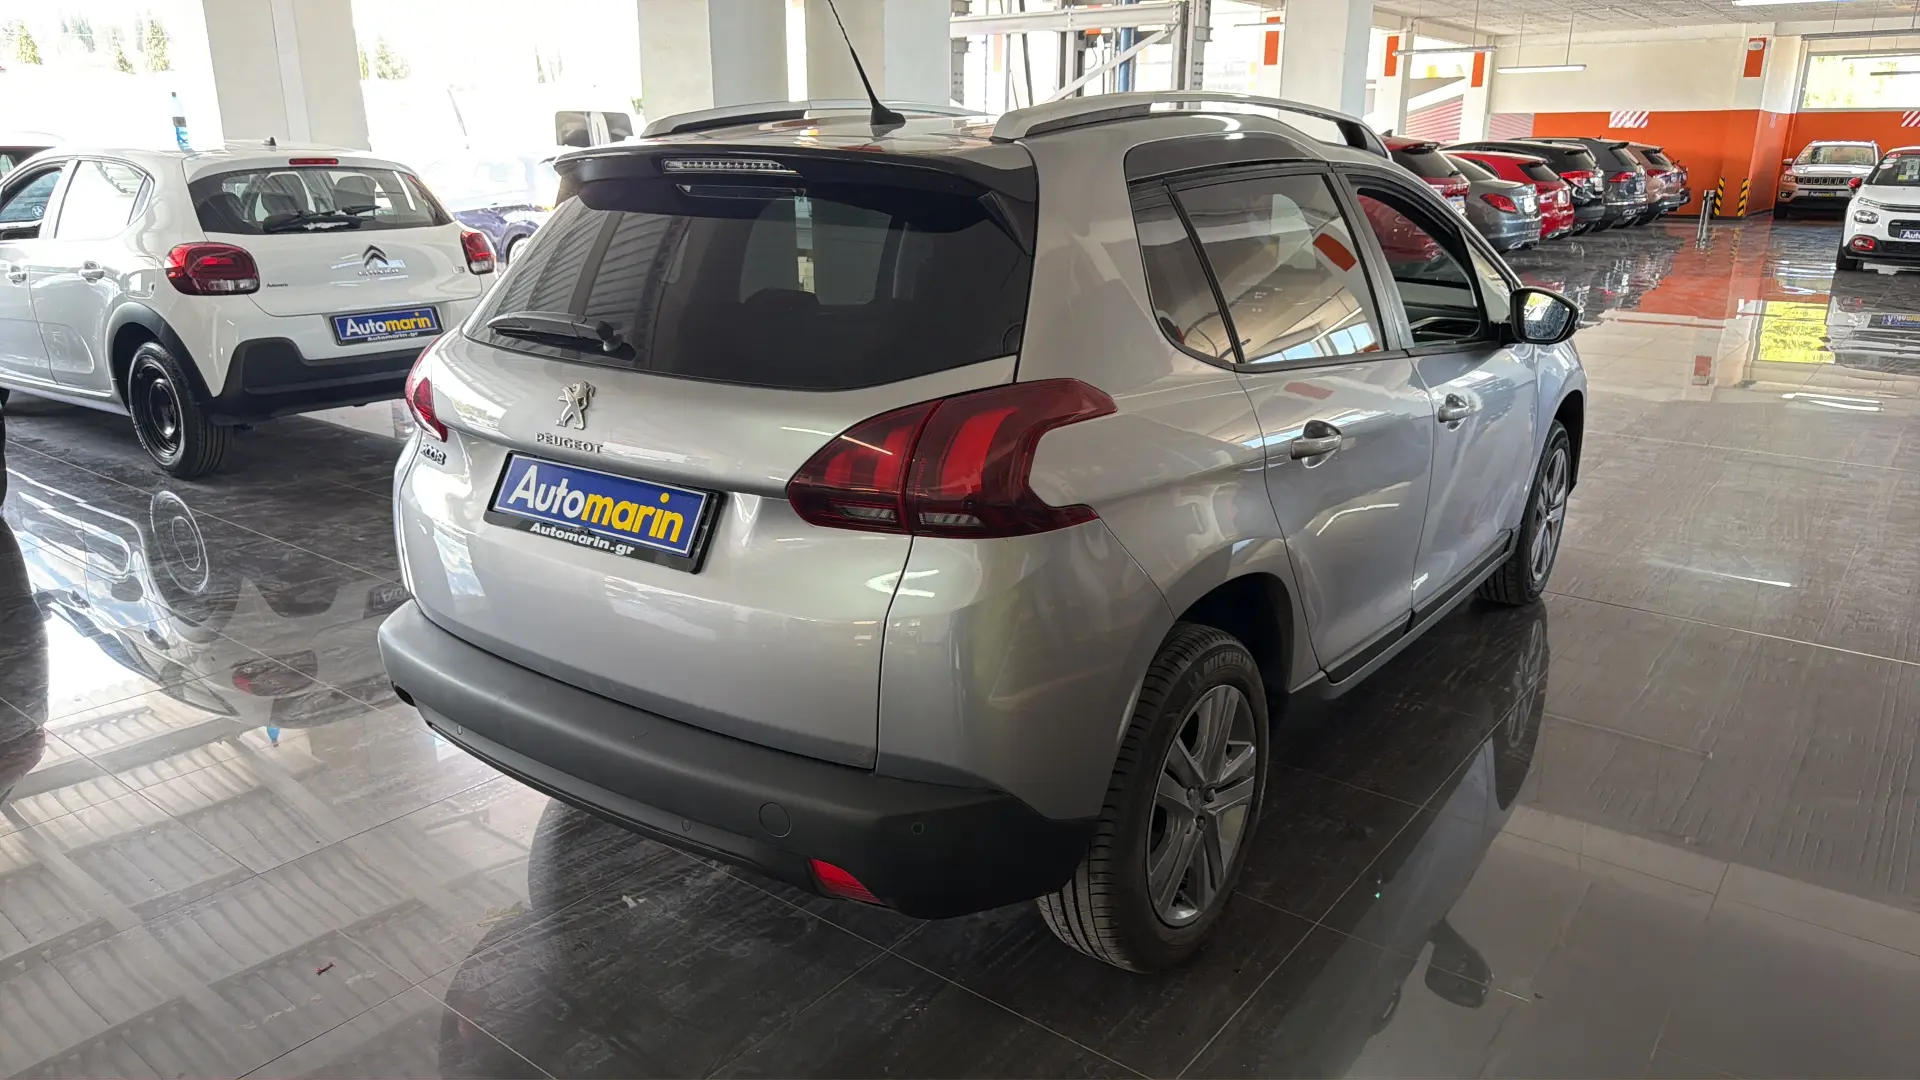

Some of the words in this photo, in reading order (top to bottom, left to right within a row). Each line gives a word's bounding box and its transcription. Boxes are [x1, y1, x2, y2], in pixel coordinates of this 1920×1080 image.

[346, 312, 431, 336] Automarin
[367, 332, 418, 342] Automarin.gr
[535, 432, 604, 453] PEUGEOT
[507, 464, 684, 542] Automarin
[530, 522, 635, 556] Automarin.gr
[1203, 651, 1252, 673] MICHELIN
